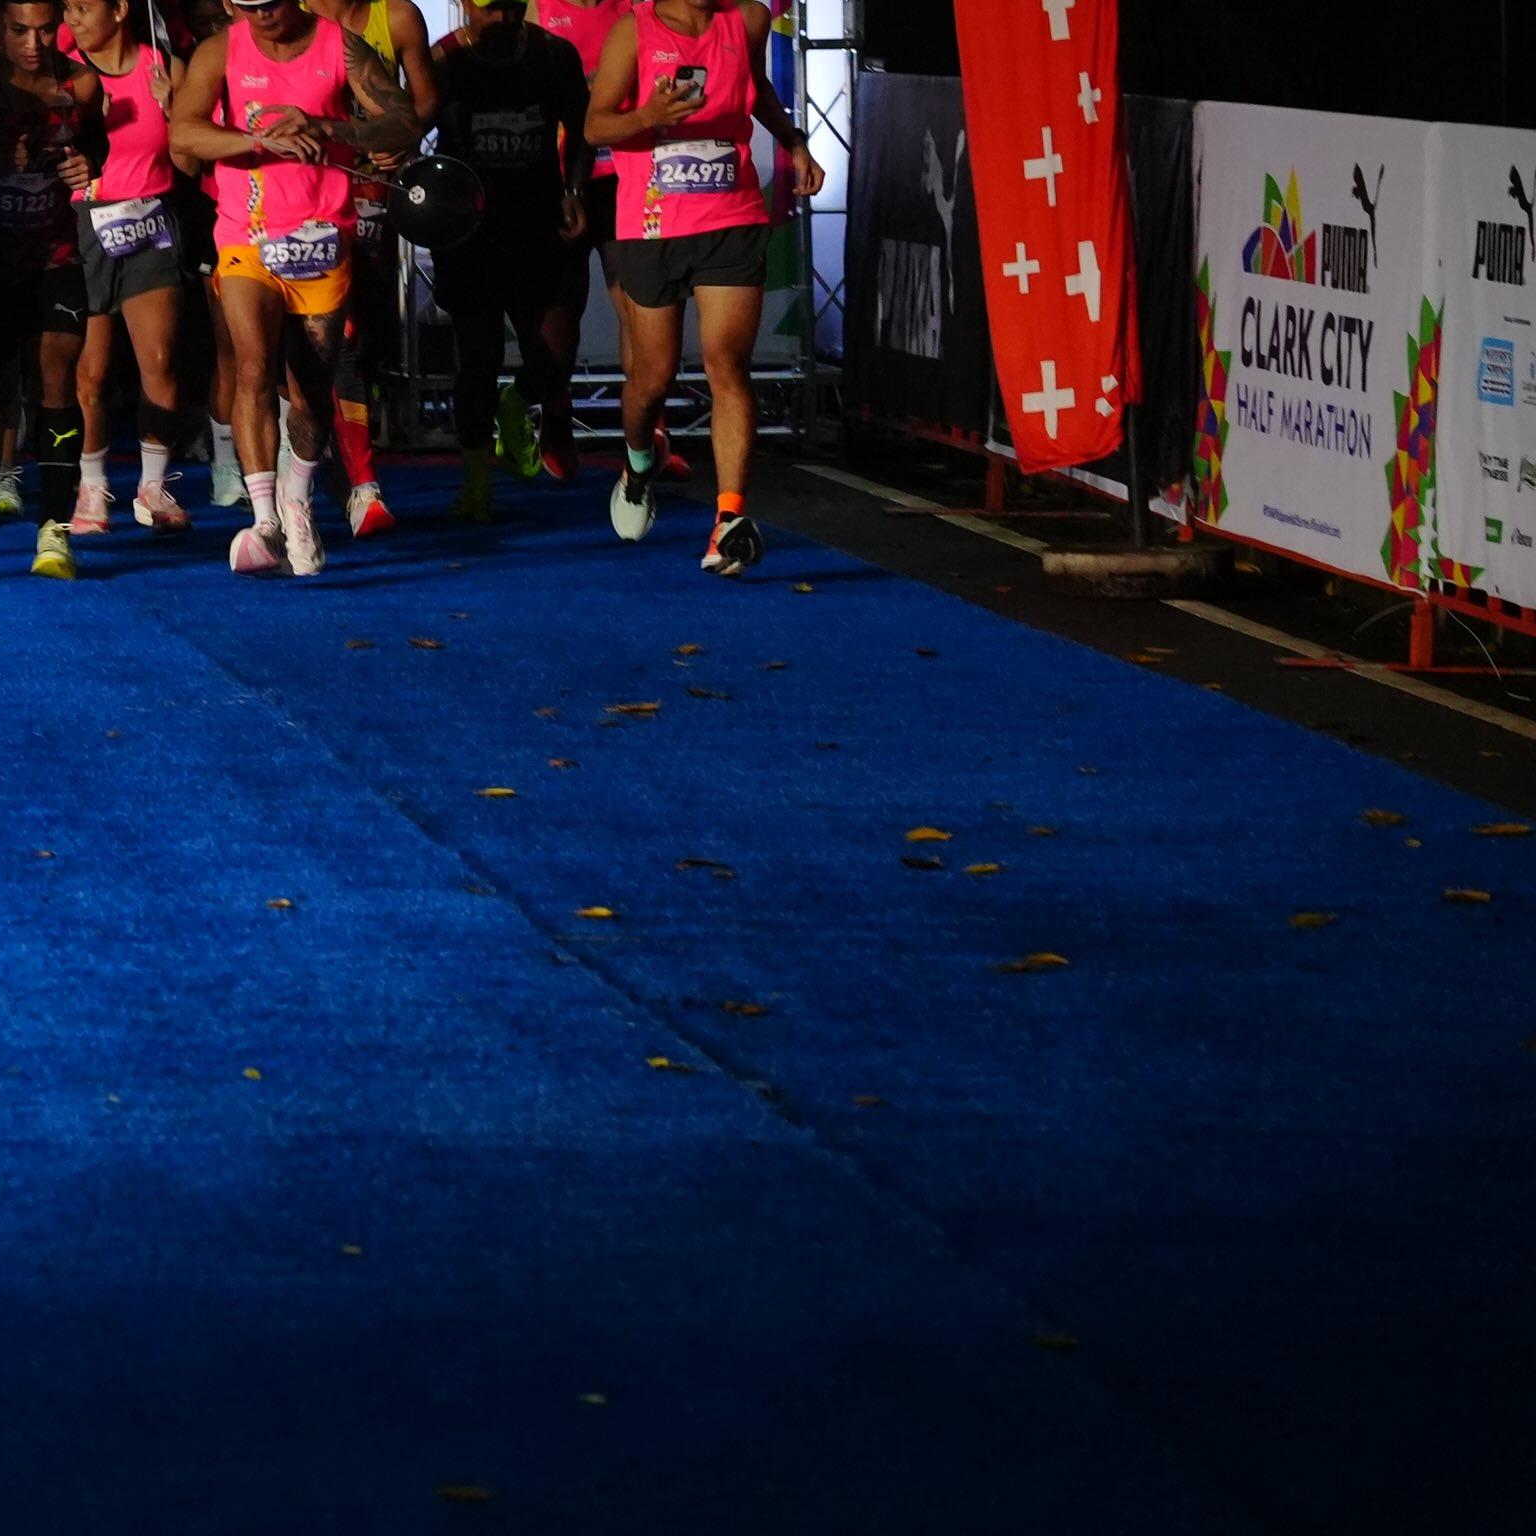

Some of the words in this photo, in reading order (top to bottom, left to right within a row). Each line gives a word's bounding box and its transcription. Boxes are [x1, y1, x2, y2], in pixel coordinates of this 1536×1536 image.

[661, 162, 725, 183] 24497
[101, 216, 157, 249] 25380
[262, 242, 326, 264] 25374
[1320, 222, 1370, 295] PUMA
[1471, 219, 1526, 286] PUMA
[1240, 294, 1313, 383] CLARK
[1319, 309, 1374, 394] CITY
[1237, 380, 1276, 437] HALF
[1279, 393, 1372, 463] MARATHON
